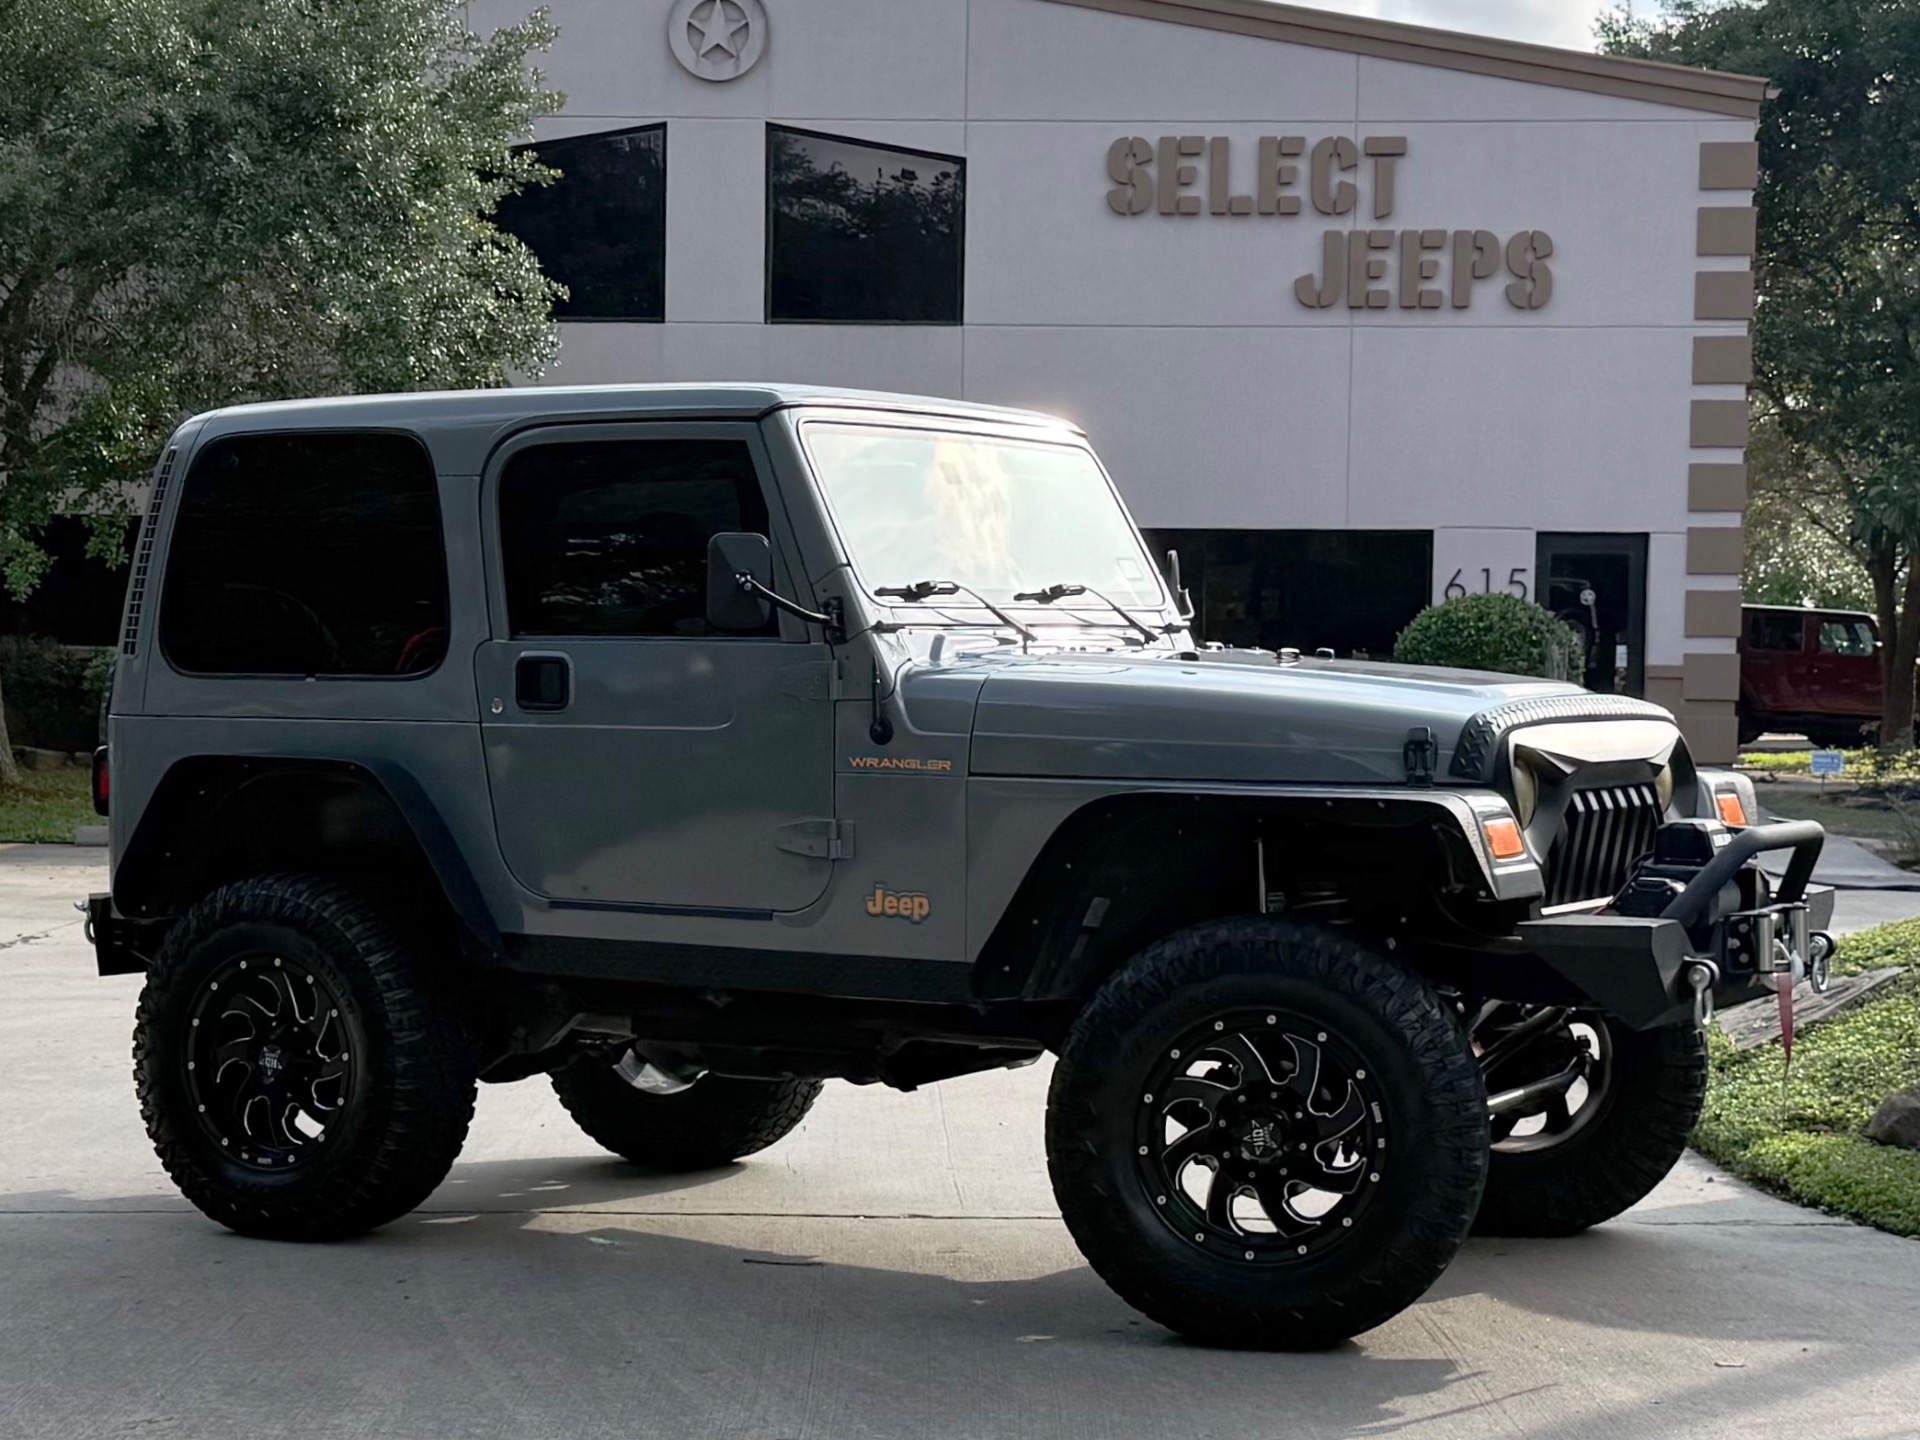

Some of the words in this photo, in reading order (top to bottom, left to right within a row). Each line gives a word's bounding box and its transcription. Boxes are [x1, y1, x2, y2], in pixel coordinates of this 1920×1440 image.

[1106, 136, 1407, 219] SELECT
[1294, 229, 1553, 309] JEEPS
[1444, 567, 1528, 600] 615
[848, 757, 952, 771] WRANGLER
[865, 884, 931, 922] Jeep
